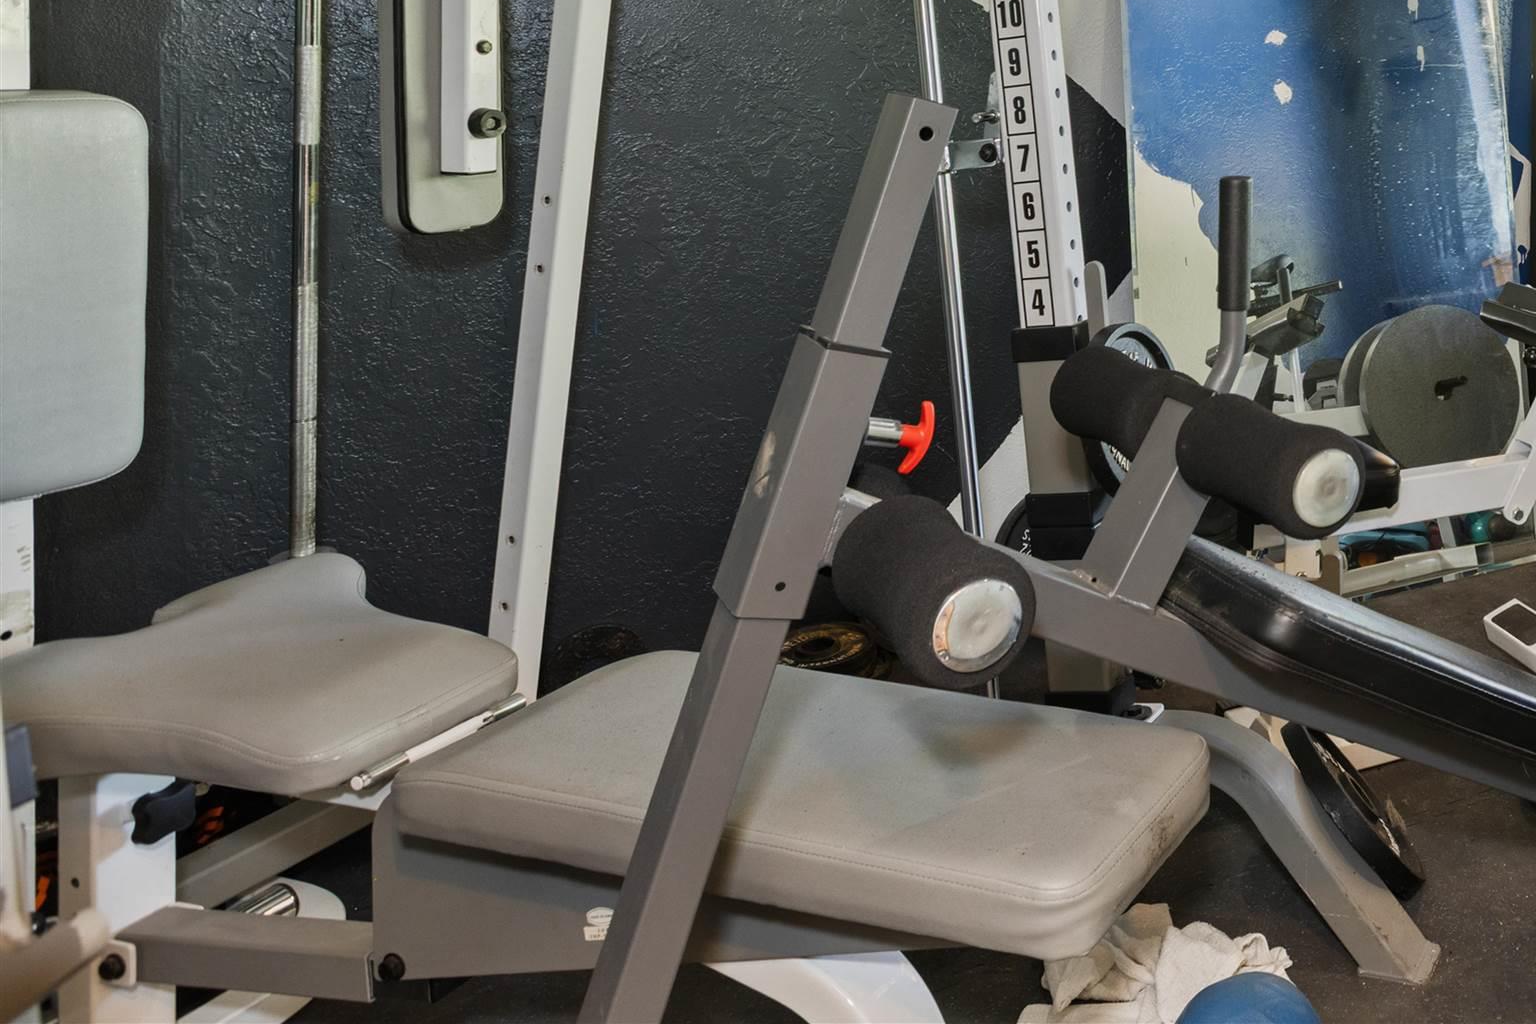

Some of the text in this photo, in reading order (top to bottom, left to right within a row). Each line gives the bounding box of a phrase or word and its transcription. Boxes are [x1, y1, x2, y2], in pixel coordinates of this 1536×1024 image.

[997, 0, 1022, 29] 10
[1007, 48, 1022, 77] 9
[1013, 96, 1027, 125] 8
[1017, 144, 1030, 173] 7
[1022, 192, 1036, 221] 6
[1026, 240, 1040, 268] 5
[1031, 288, 1046, 316] 4
